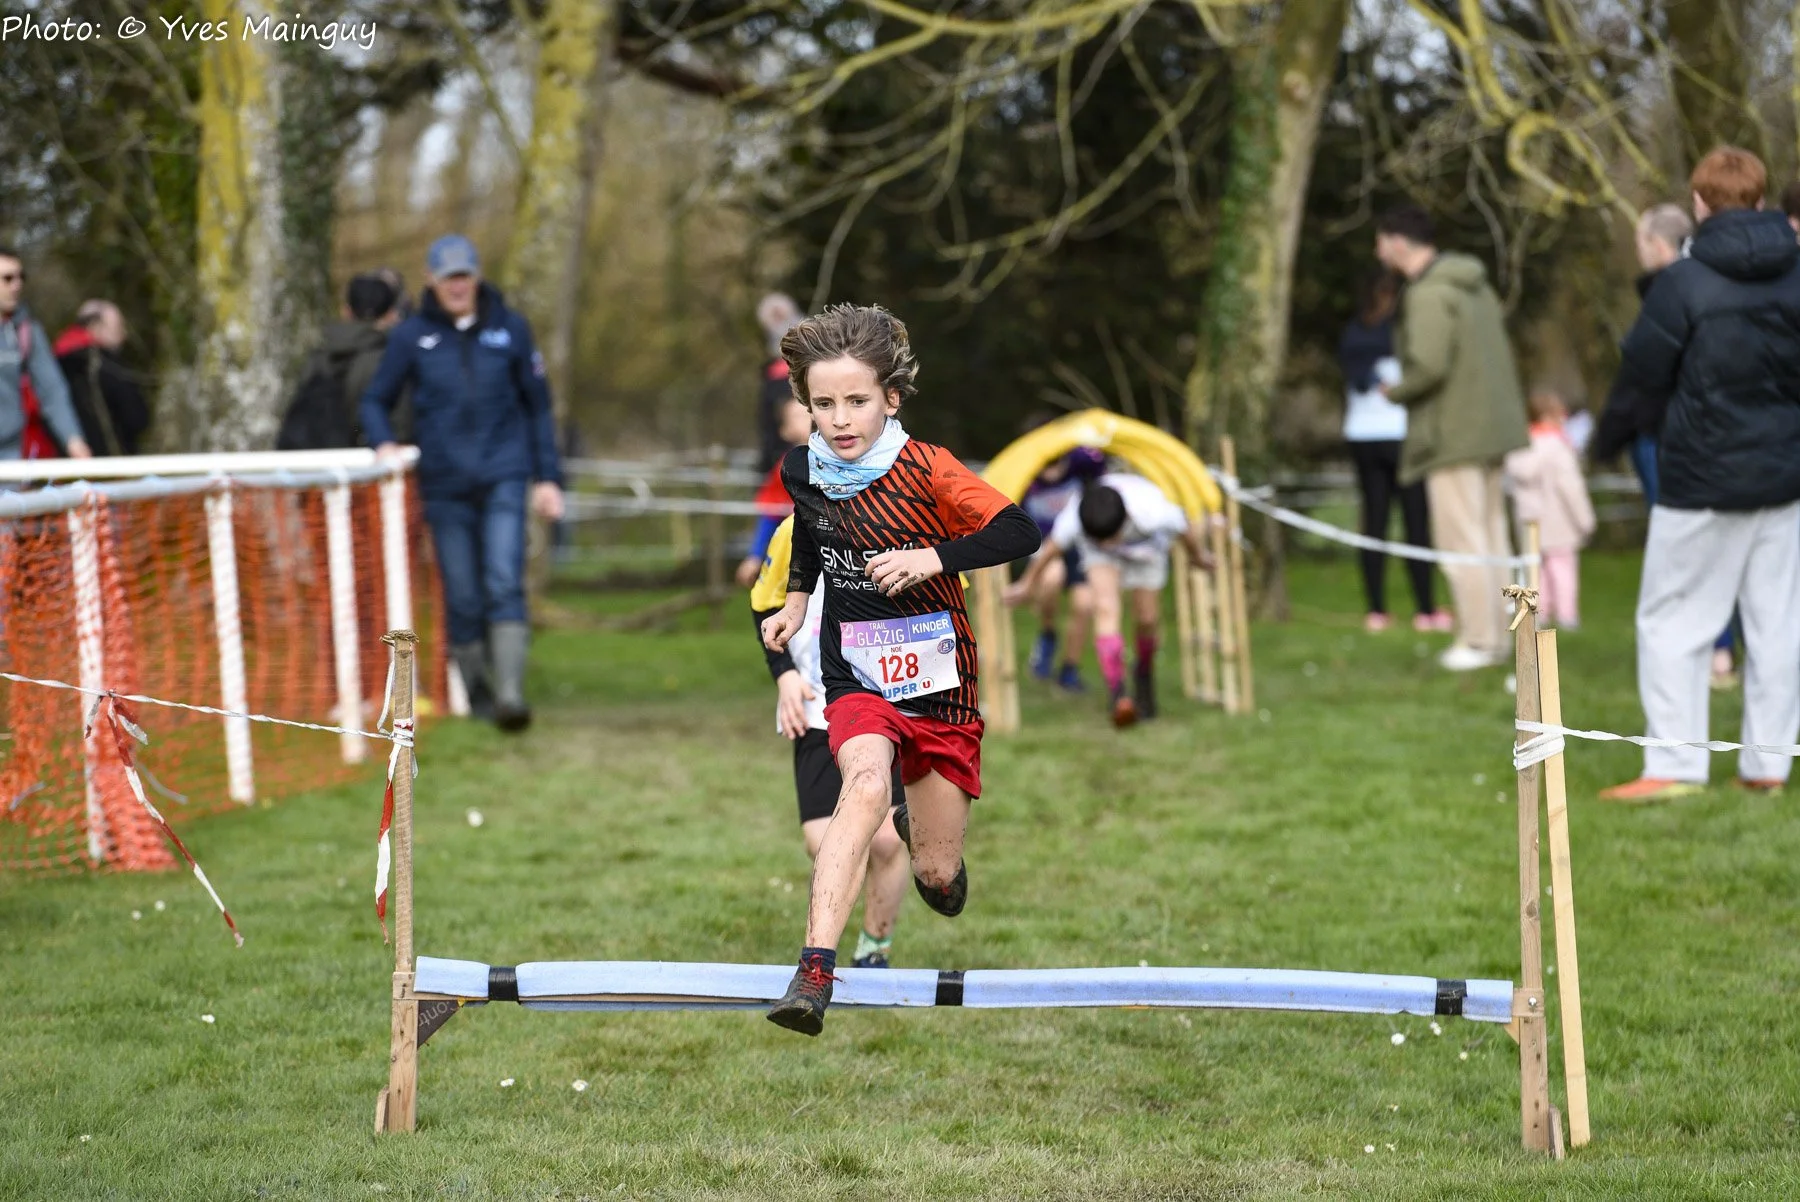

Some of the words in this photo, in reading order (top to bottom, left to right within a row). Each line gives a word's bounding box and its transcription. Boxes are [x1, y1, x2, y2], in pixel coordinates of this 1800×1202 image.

[832, 578, 894, 591] SAVE
[856, 628, 905, 647] GLAZIG
[912, 618, 950, 634] KINDER
[869, 622, 888, 630] TRAIL
[878, 652, 919, 684] 128
[882, 682, 918, 699] UPER
